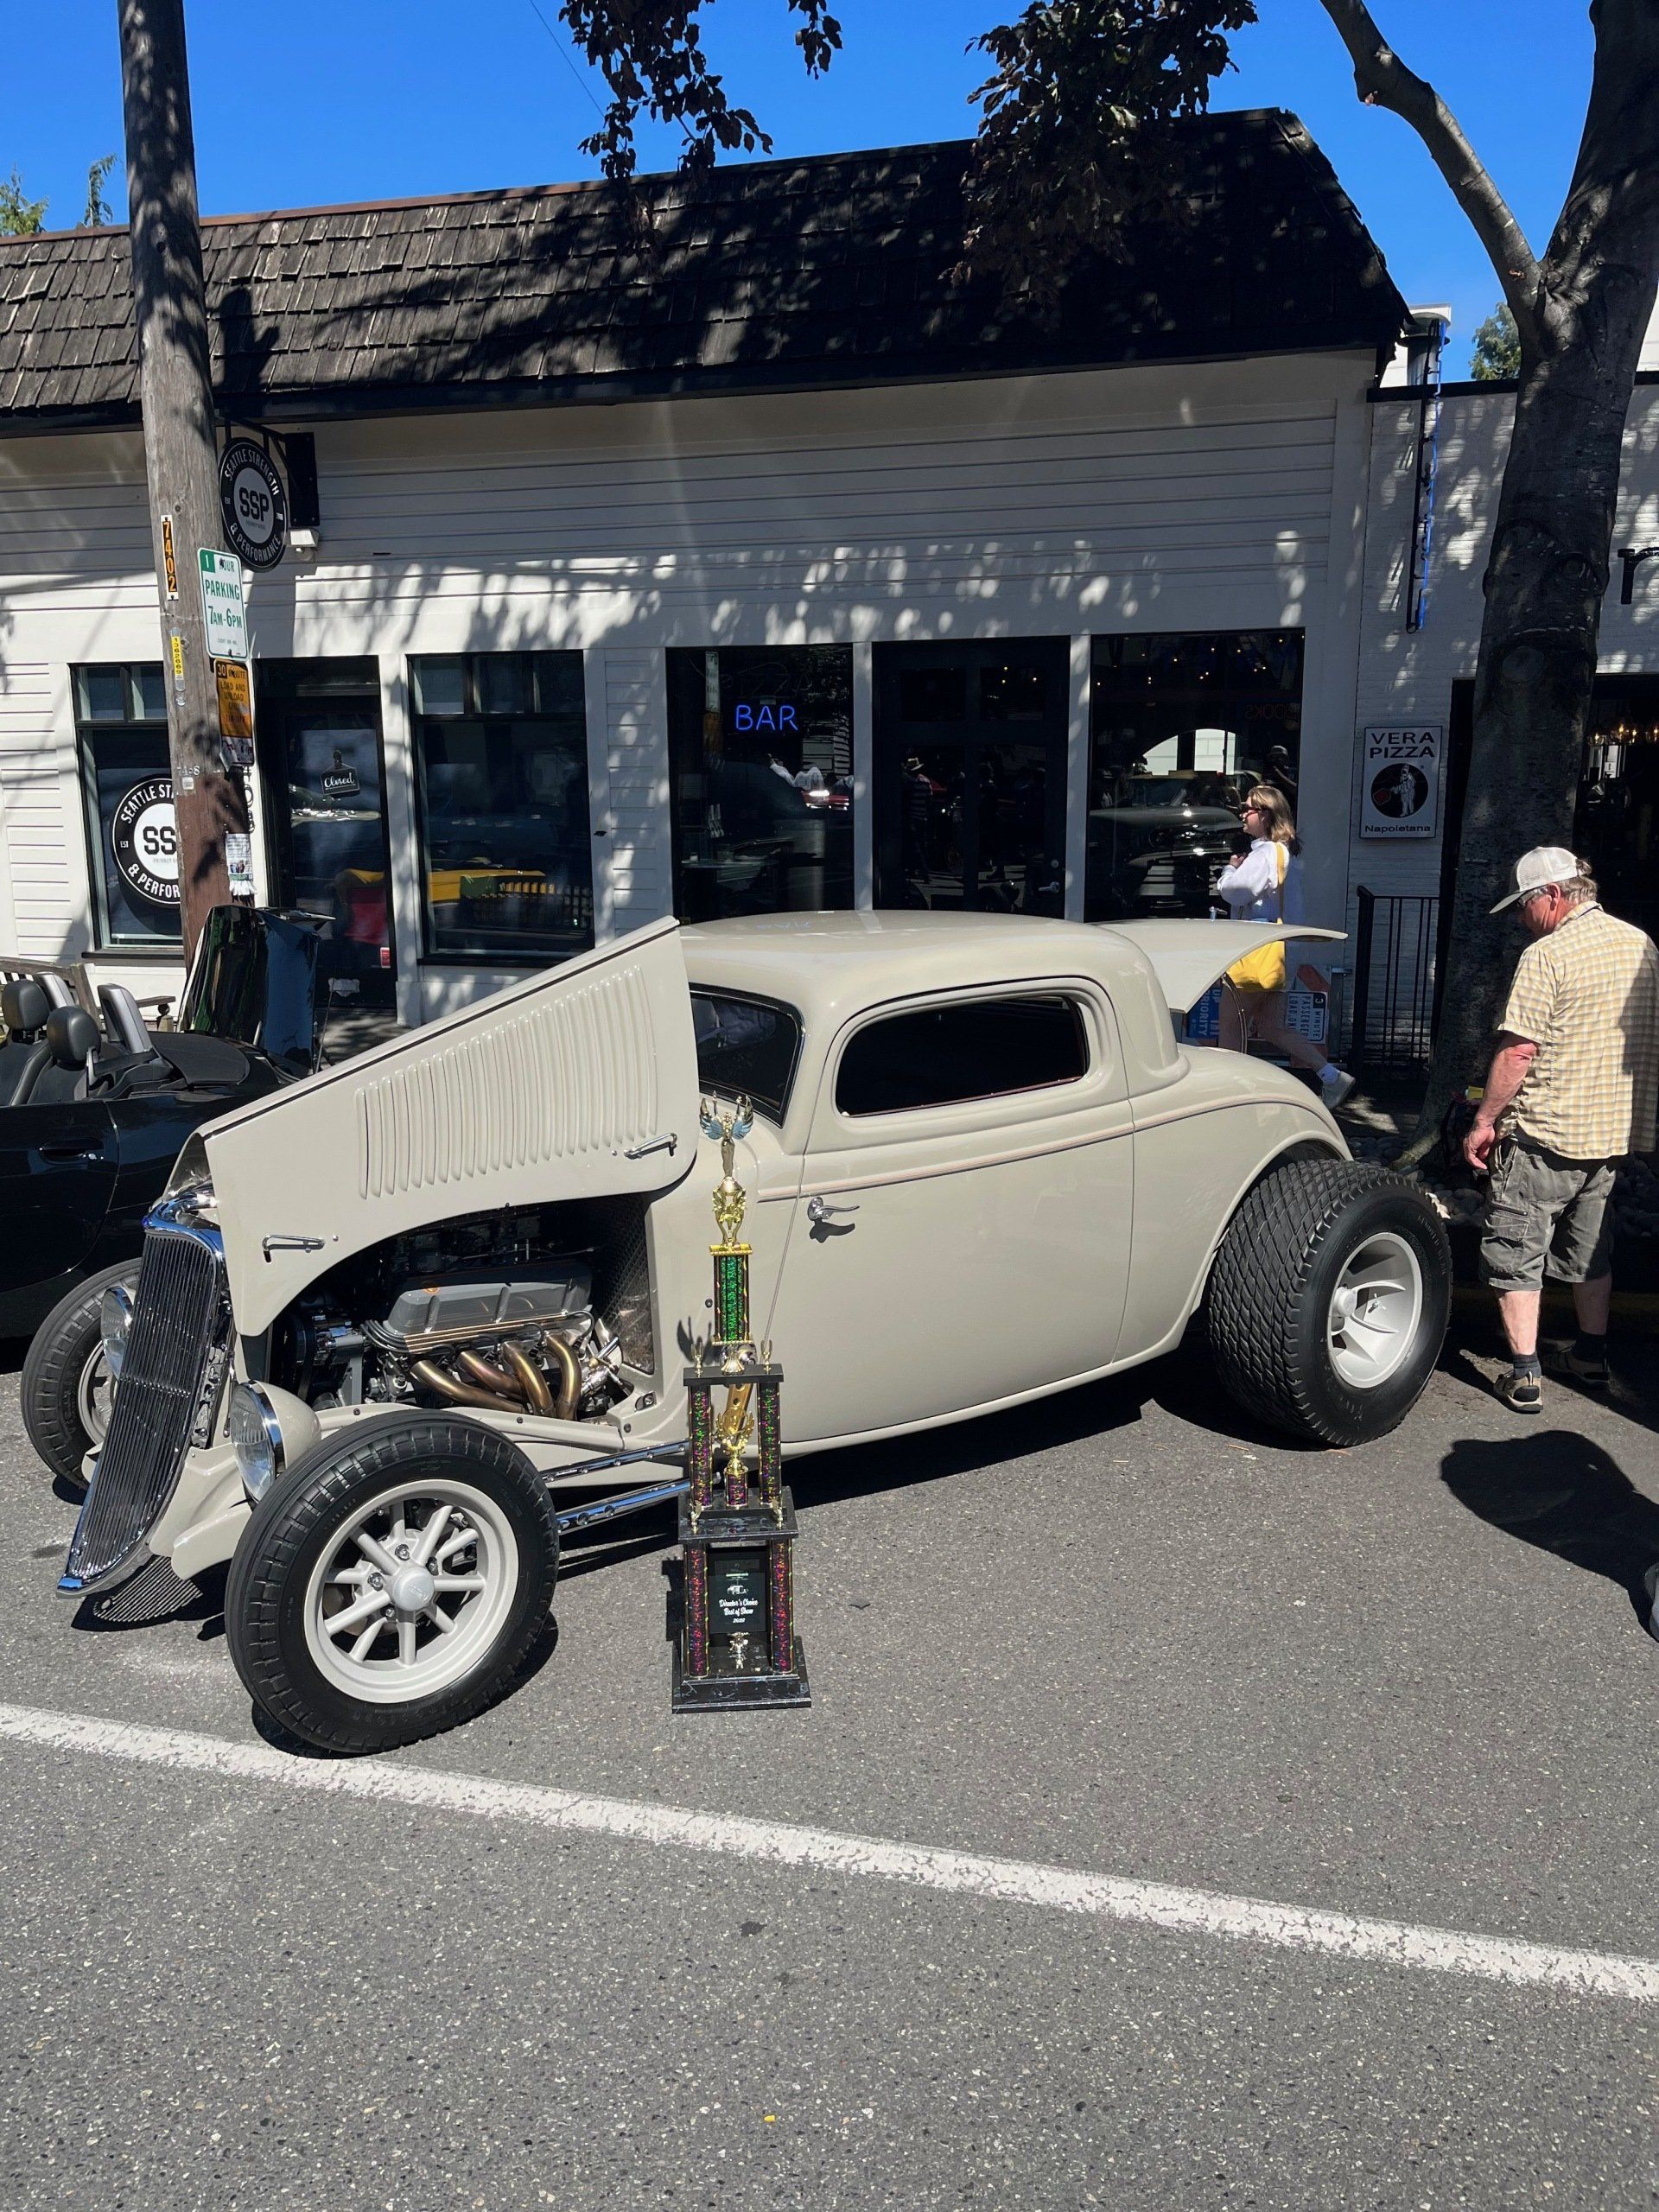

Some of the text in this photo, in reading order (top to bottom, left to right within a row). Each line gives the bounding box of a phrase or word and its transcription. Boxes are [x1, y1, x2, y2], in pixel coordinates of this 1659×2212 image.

[225, 448, 280, 496] SEATTLE STRENGTH
[238, 486, 269, 522] SSP
[230, 522, 238, 535] &
[236, 534, 282, 563] PERFORMANCE
[163, 522, 176, 592] 7402
[205, 554, 209, 569] 1
[205, 579, 240, 600] PARKING
[207, 605, 243, 628] 7AM-6PM
[174, 637, 182, 674] 1362669
[217, 664, 246, 679] 30 MUTE
[220, 681, 246, 692] LOAD AND
[735, 704, 798, 731] BAR
[1371, 732, 1435, 745] VERA
[1370, 746, 1435, 759] PIZZA
[323, 772, 355, 788] Closed
[120, 785, 157, 824] SEATTLE
[143, 825, 177, 855] SS
[1364, 824, 1431, 834] Napoletana
[128, 863, 181, 899] & PERFOR
[1288, 995, 1299, 1014] LOAD
[1313, 1011, 1322, 1037] MINUTE
[734, 1608, 741, 1618] of
